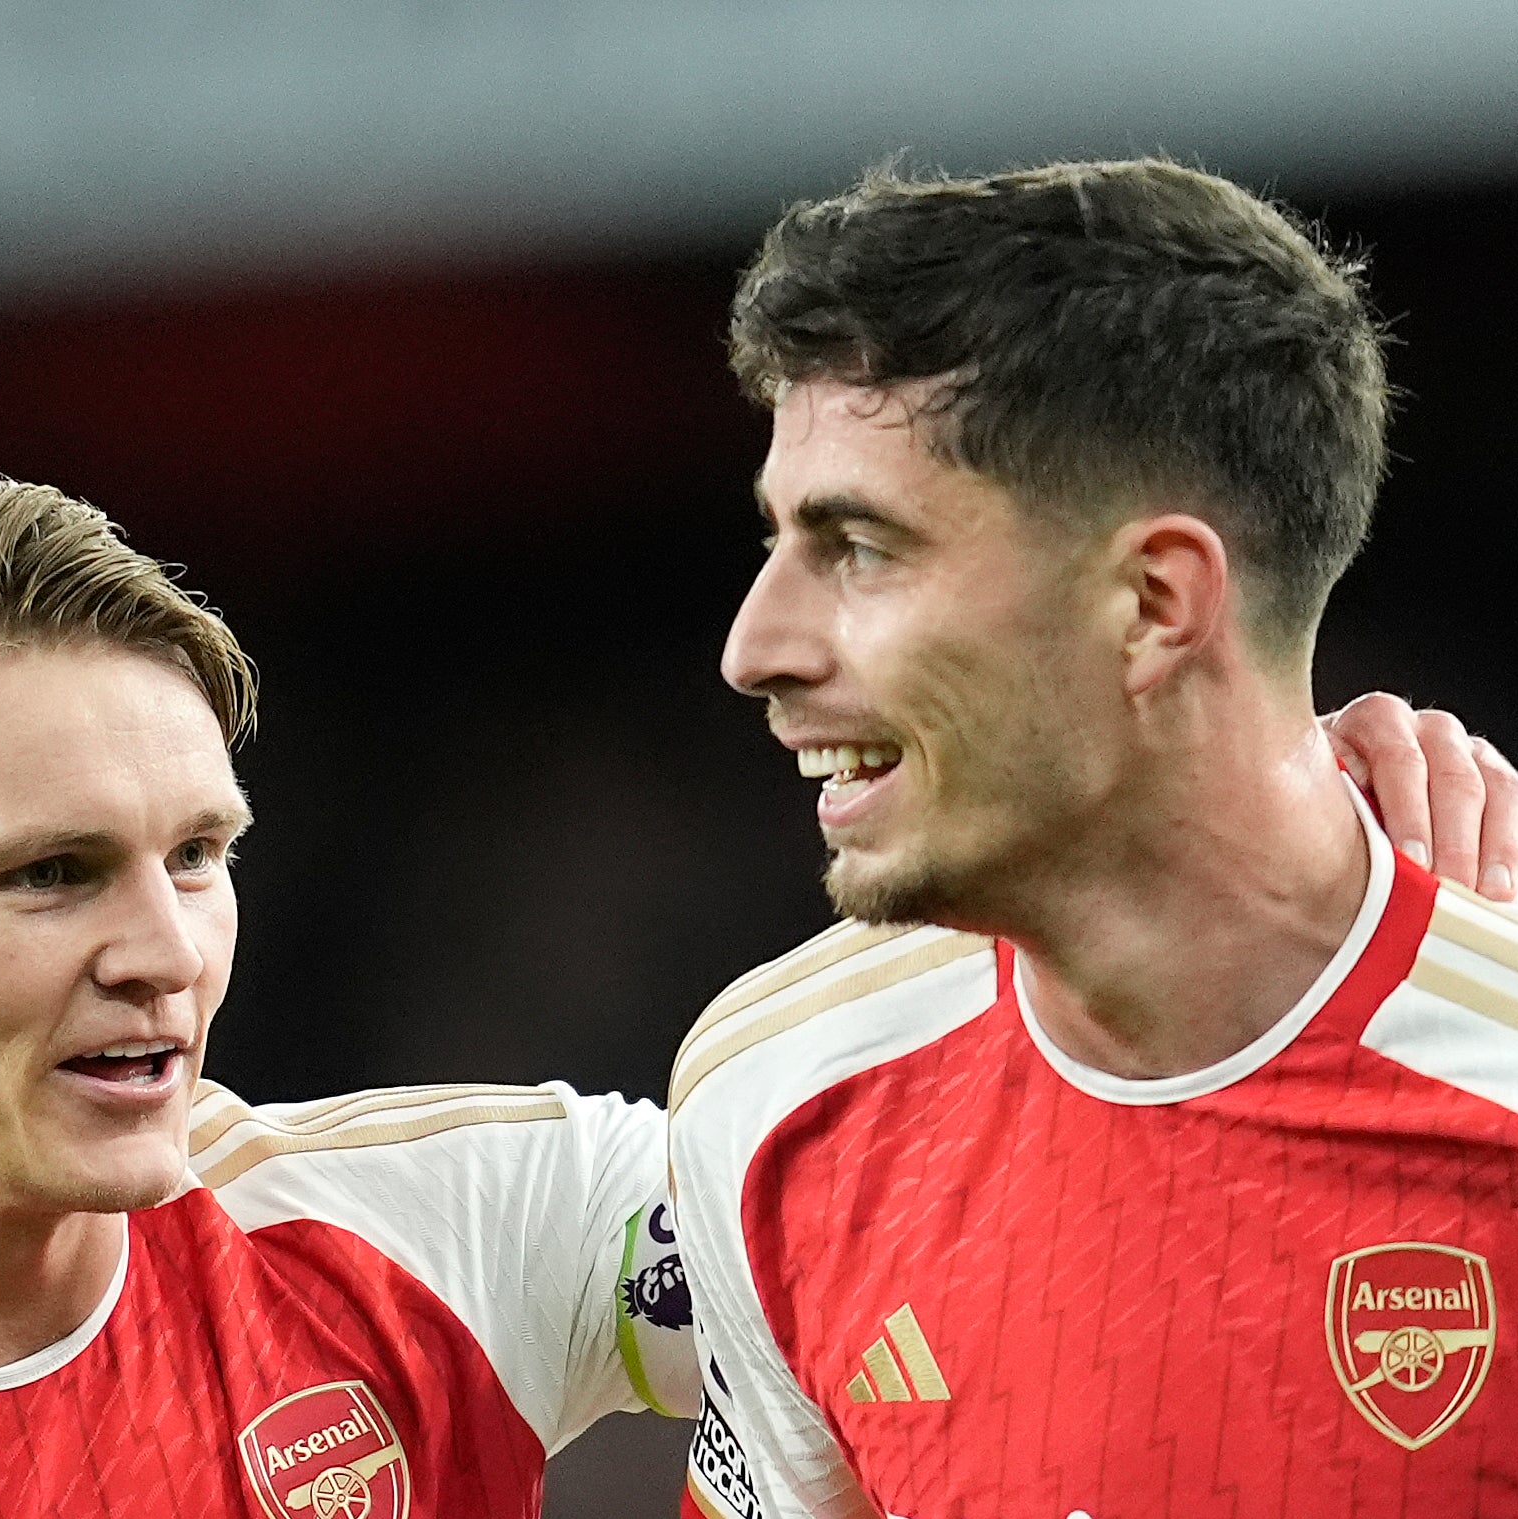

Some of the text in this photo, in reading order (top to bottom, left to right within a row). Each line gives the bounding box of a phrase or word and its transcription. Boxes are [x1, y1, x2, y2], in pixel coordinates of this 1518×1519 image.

[648, 1202, 676, 1244] C
[1351, 1279, 1471, 1312] Arsenal
[264, 1408, 372, 1478] Arsenal
